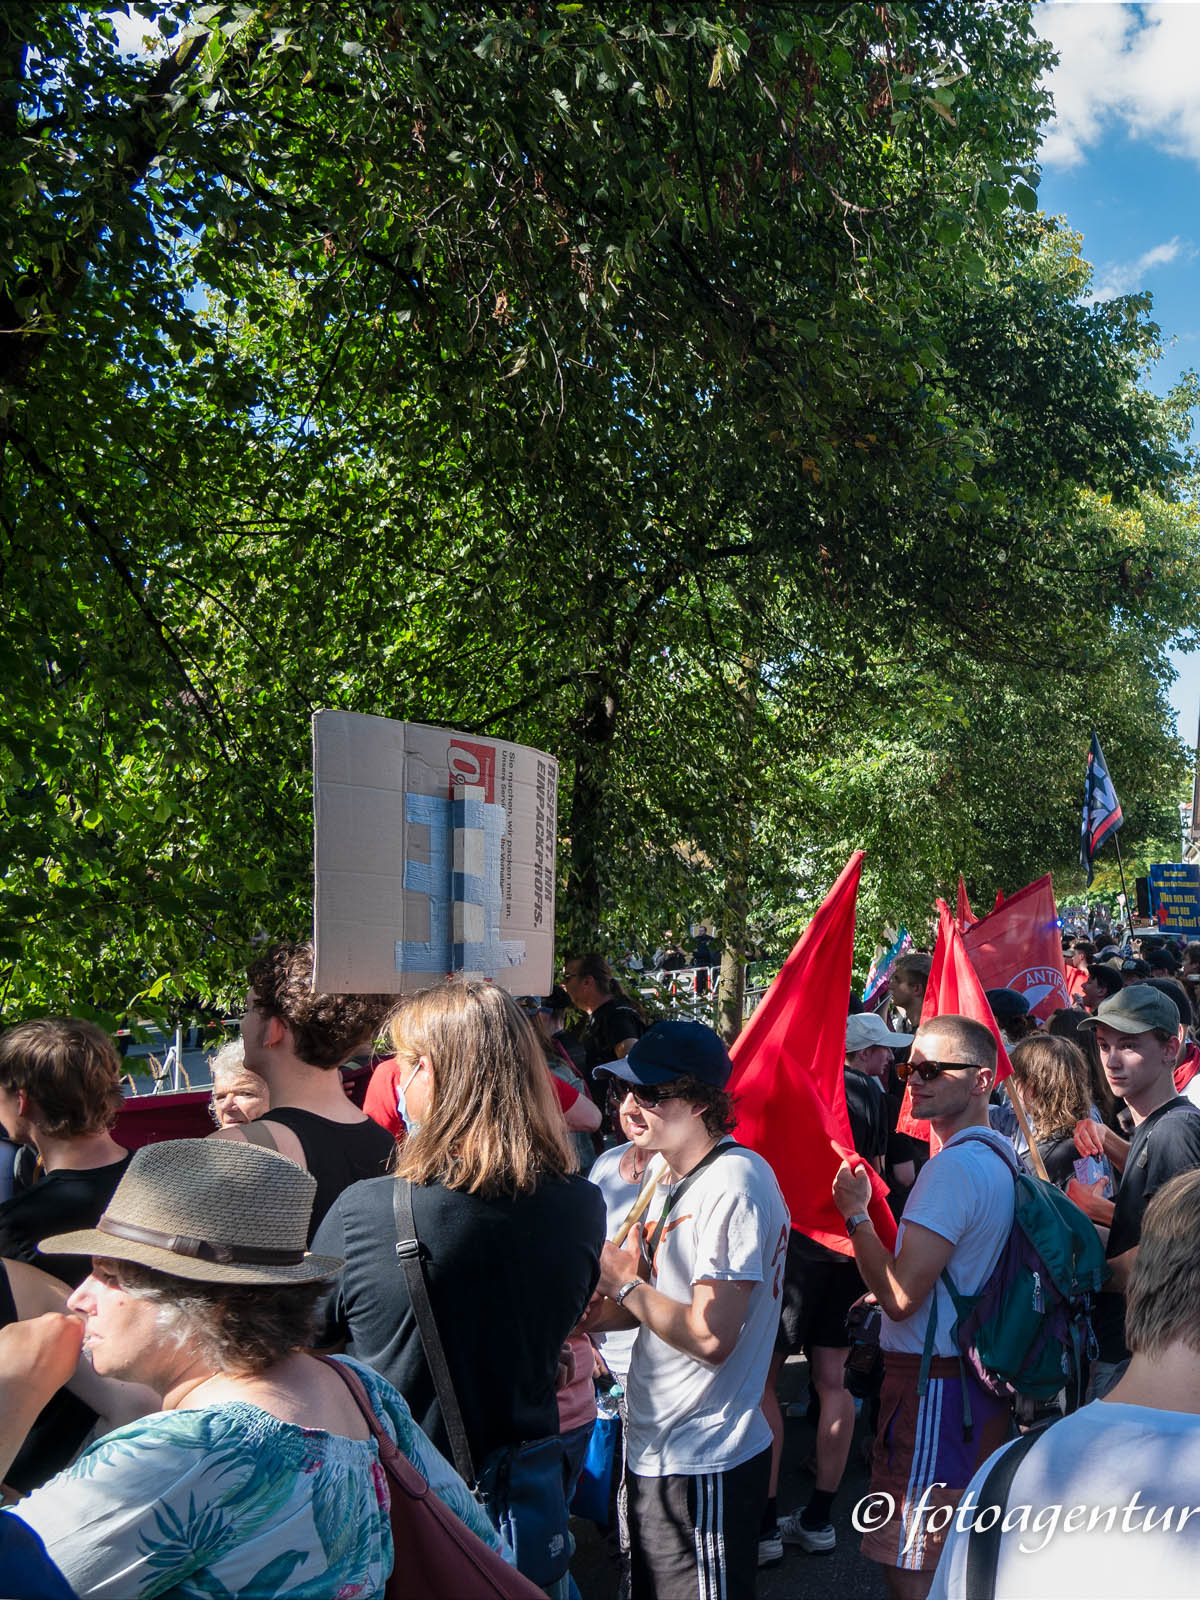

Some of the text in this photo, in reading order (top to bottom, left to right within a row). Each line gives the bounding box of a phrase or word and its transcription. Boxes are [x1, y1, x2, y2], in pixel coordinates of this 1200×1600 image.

[508, 751, 516, 769] Sie
[506, 771, 515, 817] machen,
[534, 760, 546, 928] EINPACKPROFIS.
[544, 763, 556, 903] RESPEKT. IHR
[505, 840, 513, 880] packen
